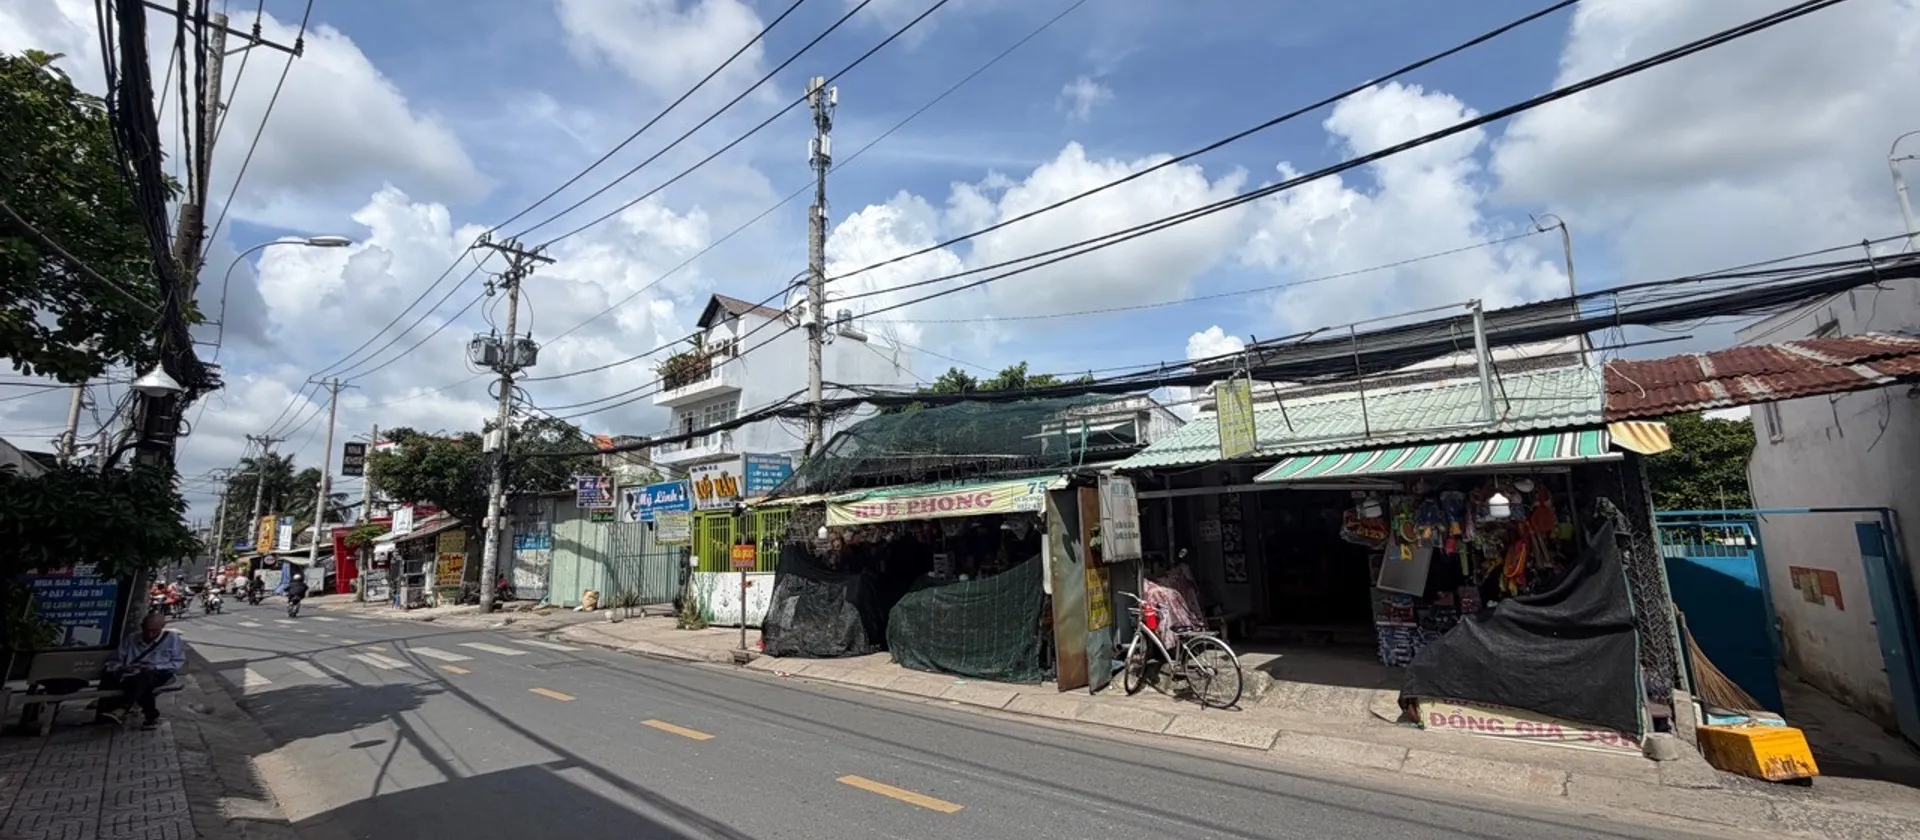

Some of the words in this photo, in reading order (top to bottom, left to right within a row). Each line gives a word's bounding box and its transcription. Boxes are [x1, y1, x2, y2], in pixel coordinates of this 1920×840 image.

[654, 488, 678, 504] Linh
[1028, 481, 1049, 495] 75
[906, 491, 993, 514] PHONG
[1429, 707, 1506, 733] ĐỒNG
[1514, 719, 1565, 741] GIÁ
